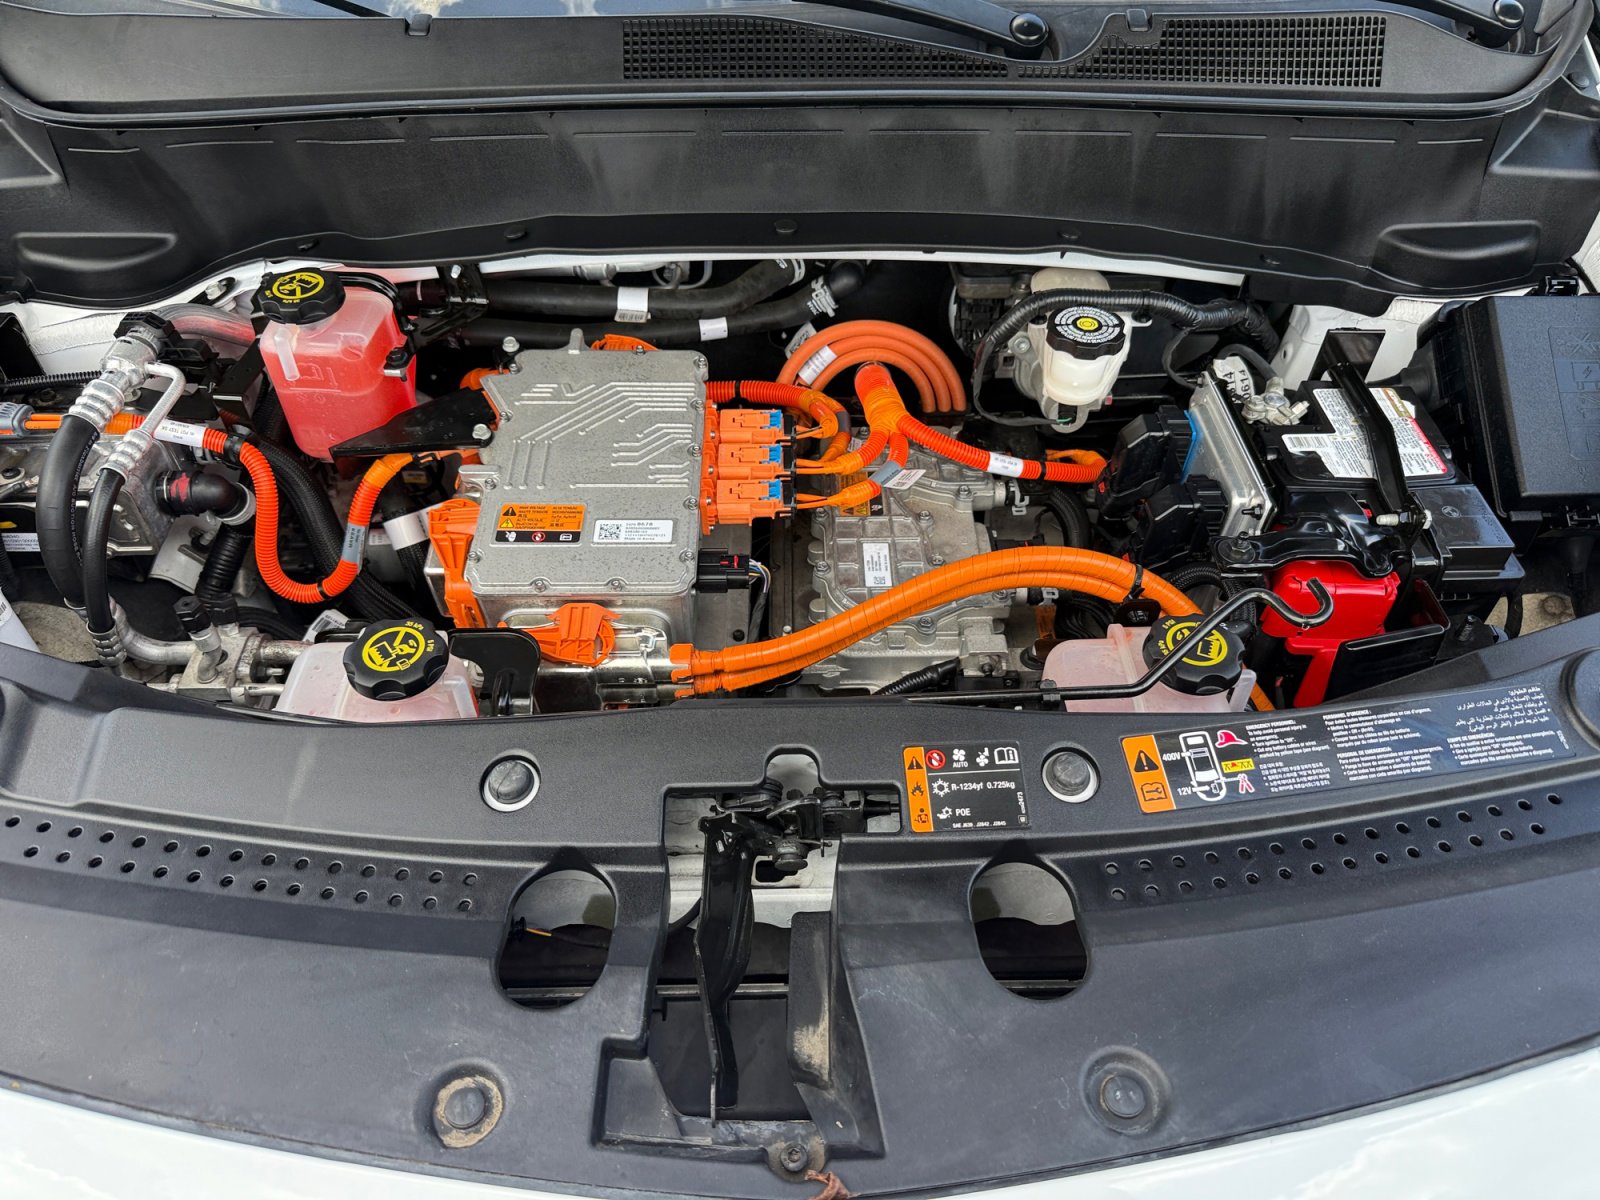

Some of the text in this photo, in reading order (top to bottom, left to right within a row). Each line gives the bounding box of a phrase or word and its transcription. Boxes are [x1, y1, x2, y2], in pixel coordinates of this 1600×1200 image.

[1162, 752, 1181, 762] 400V
[951, 782, 983, 791] R-1234yf
[1177, 786, 1192, 796] 12V
